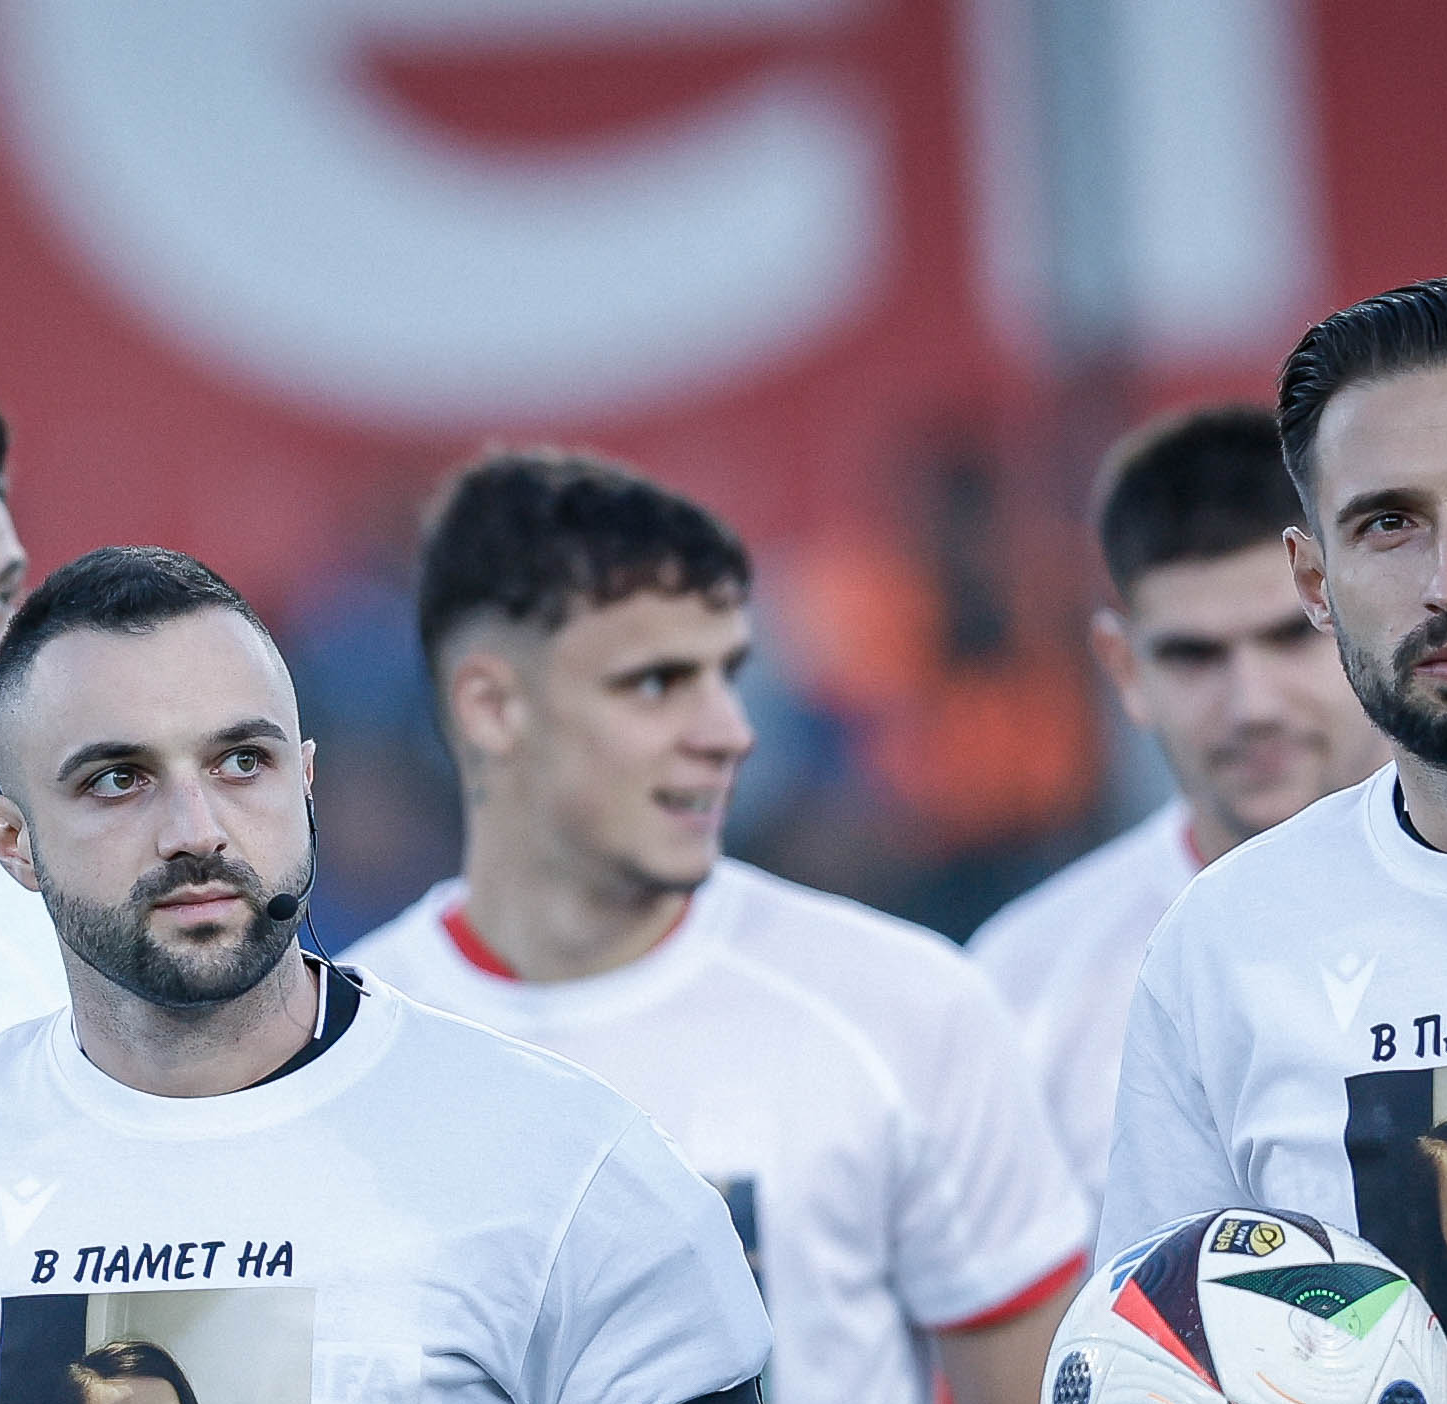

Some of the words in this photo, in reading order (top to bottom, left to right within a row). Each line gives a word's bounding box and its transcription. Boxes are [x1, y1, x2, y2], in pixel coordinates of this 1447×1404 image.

[1371, 1022, 1398, 1063] В
[30, 1249, 60, 1285] В
[73, 1241, 227, 1284] ПАМЕТ
[237, 1240, 294, 1279] НА
